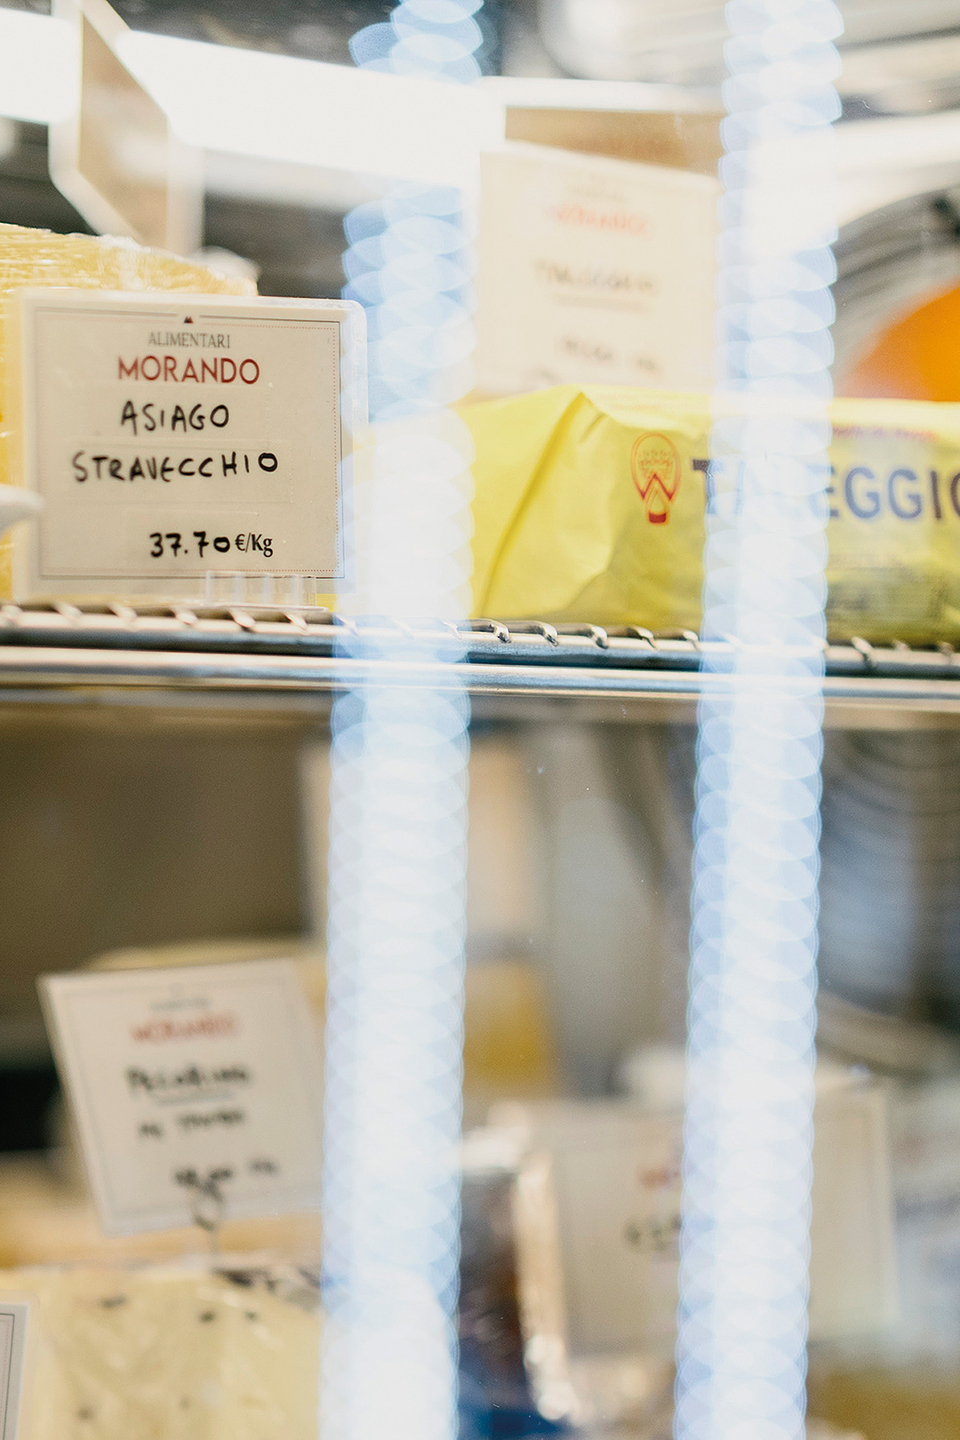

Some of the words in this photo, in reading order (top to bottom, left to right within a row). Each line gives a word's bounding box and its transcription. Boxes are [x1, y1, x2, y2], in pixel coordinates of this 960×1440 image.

[148, 331, 231, 349] ALIMENTARI
[117, 355, 260, 384] MORANDO
[121, 400, 230, 435] ASIAGO
[71, 450, 279, 482] STRAVECCHIO
[149, 531, 231, 558] 37.70
